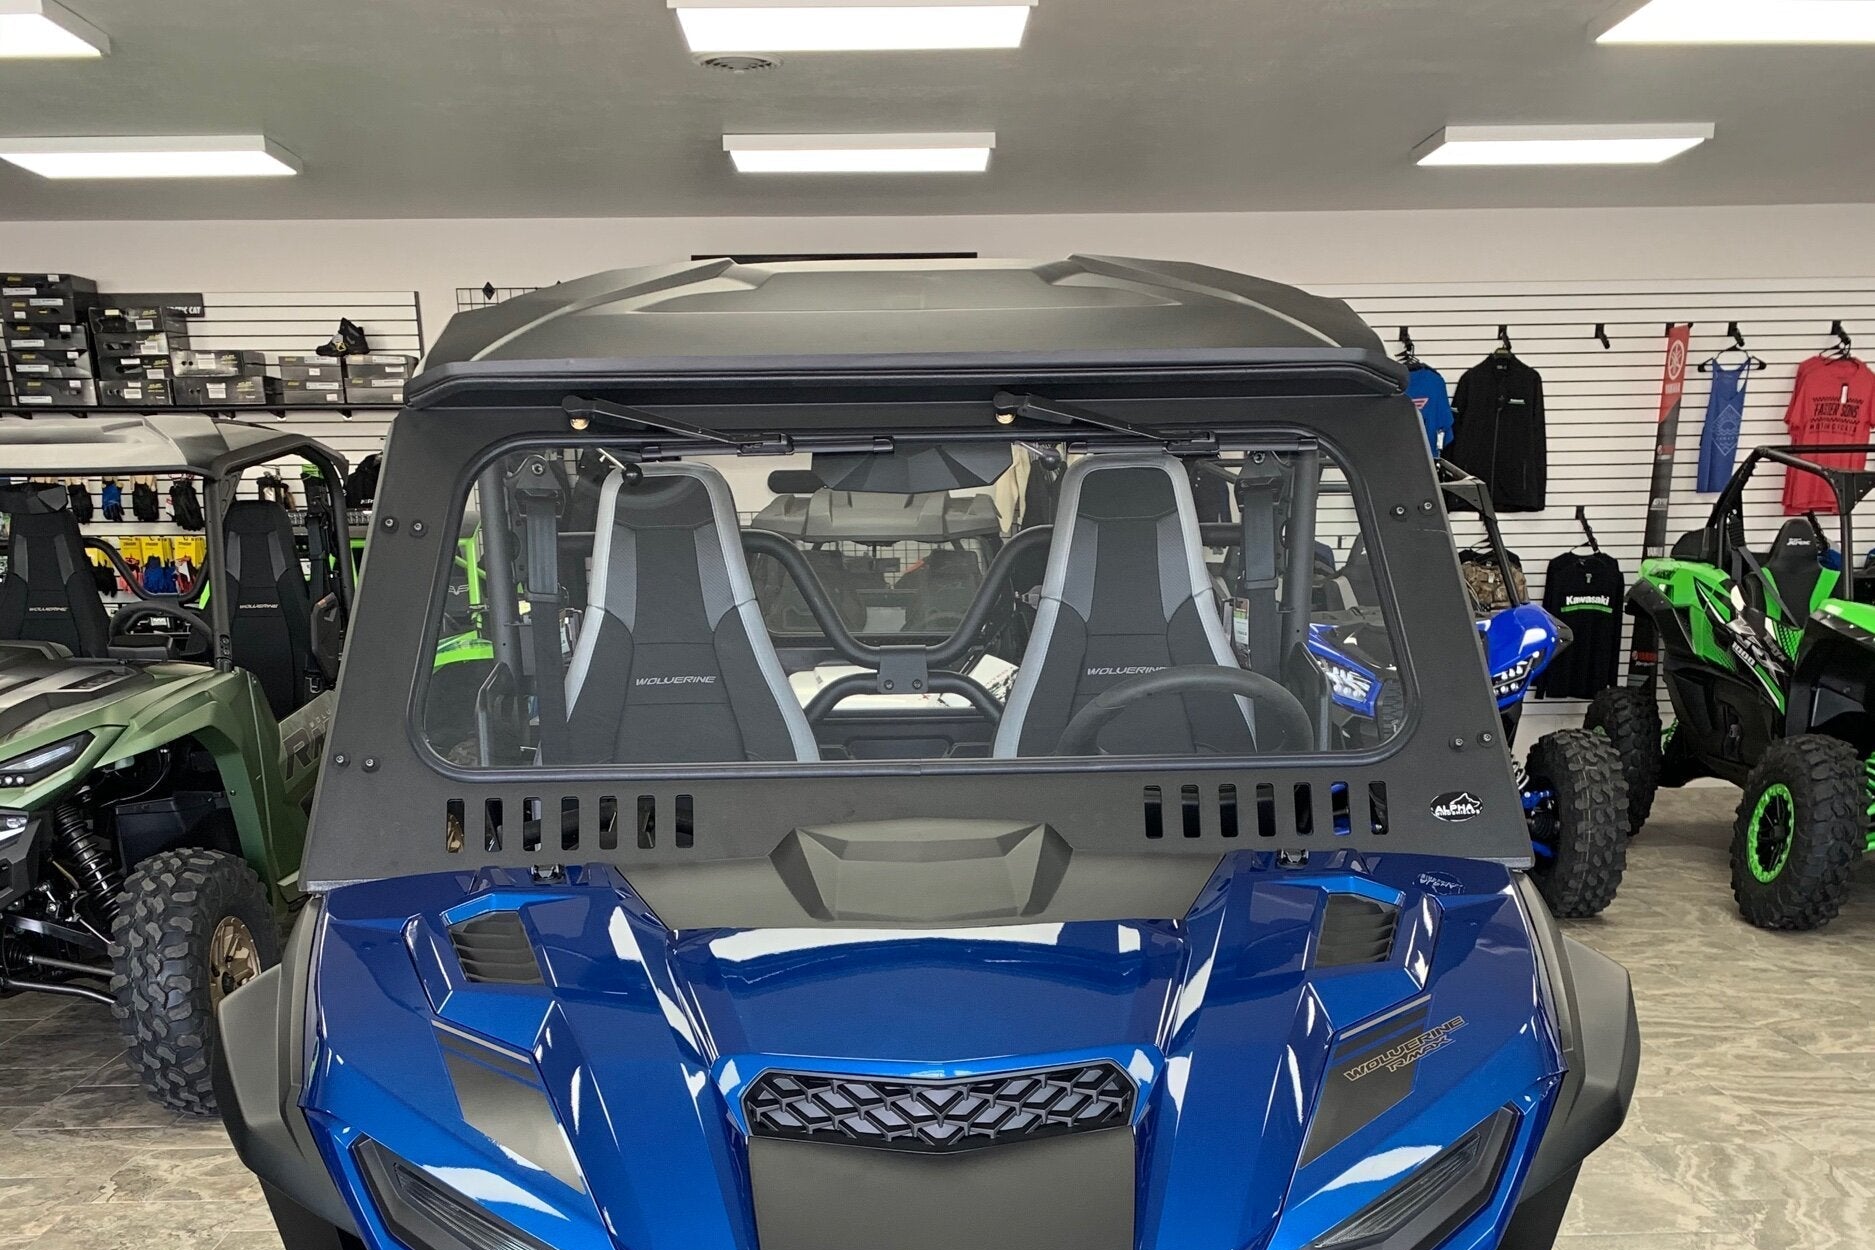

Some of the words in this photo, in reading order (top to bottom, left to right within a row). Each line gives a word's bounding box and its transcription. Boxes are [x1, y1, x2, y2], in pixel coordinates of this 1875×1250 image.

[1565, 594, 1610, 606] Kawasaki
[1731, 640, 1756, 667] 1000
[635, 675, 717, 686] WOLVERINE
[1434, 802, 1476, 813] ALPHA
[1343, 1015, 1466, 1082] WOLVERINE
[1385, 1034, 1456, 1073] RMAX
